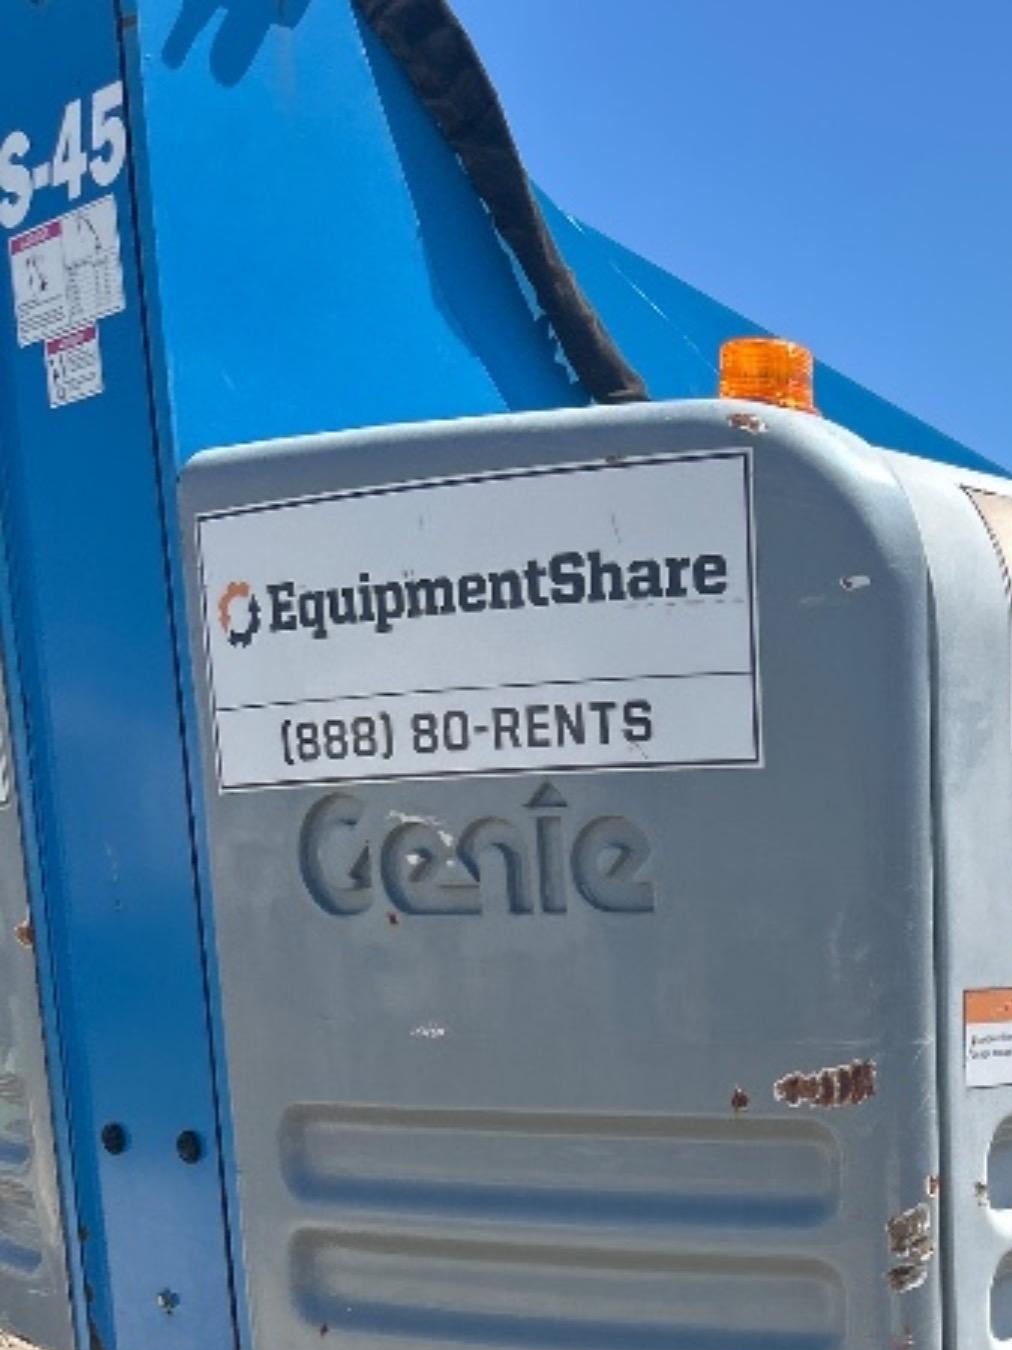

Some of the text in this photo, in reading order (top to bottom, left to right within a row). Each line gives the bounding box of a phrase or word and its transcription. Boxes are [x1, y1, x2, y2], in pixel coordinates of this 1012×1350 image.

[0, 80, 126, 228] S-45
[267, 550, 728, 640] EquipmentShare
[281, 699, 653, 766] (888) 80-RENTS
[300, 780, 655, 917] Genie
